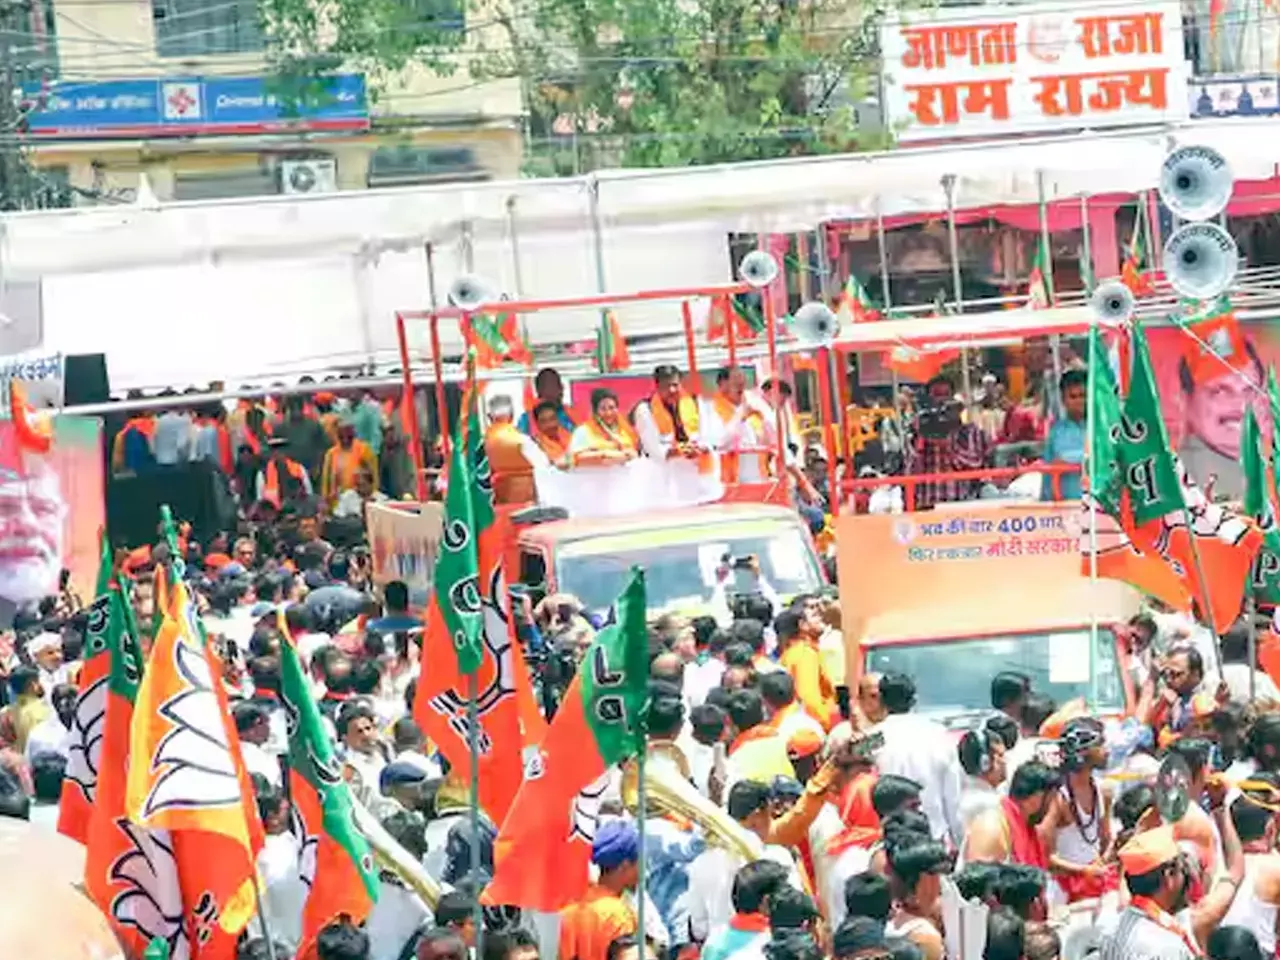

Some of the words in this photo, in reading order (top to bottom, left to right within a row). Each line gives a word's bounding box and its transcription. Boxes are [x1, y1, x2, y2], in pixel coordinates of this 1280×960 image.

[900, 22, 1017, 70] जाणता
[1074, 12, 1163, 58] राजा
[904, 78, 1012, 124] राम
[1029, 67, 1170, 116] राज्य
[997, 515, 1037, 533] 400
